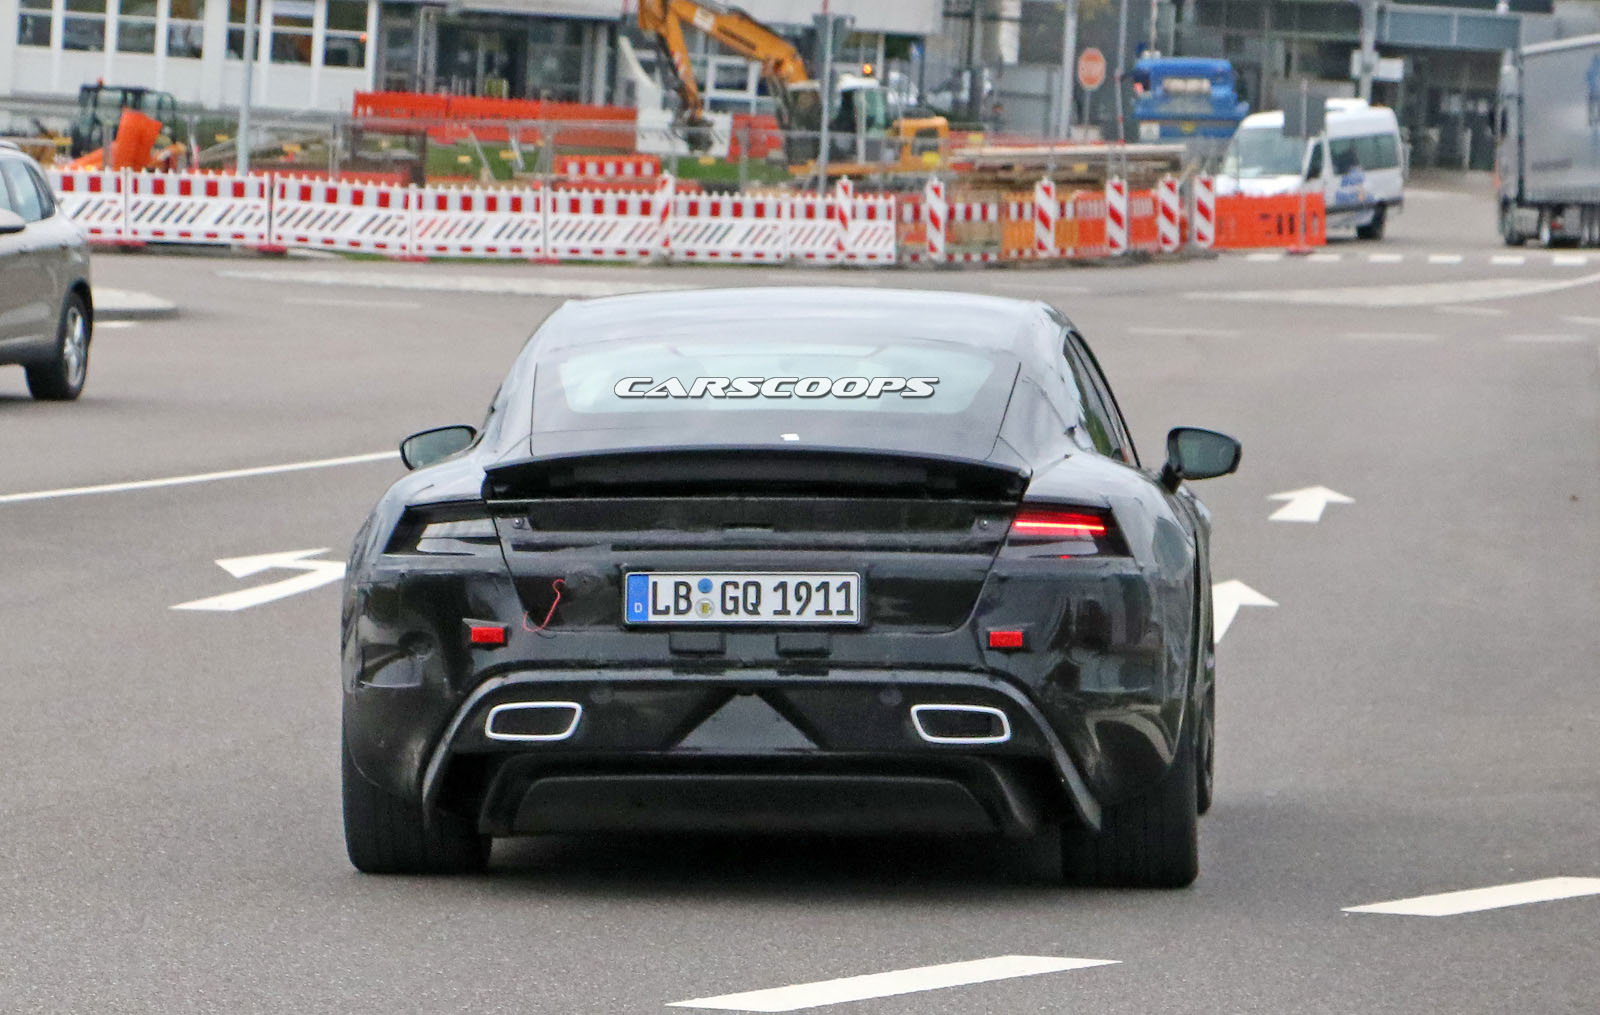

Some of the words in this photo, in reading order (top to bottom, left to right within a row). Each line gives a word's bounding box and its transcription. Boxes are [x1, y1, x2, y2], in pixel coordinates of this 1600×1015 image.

[634, 602, 643, 613] D
[652, 581, 692, 616] LB
[721, 581, 761, 616] GQ
[773, 581, 854, 616] 1911
